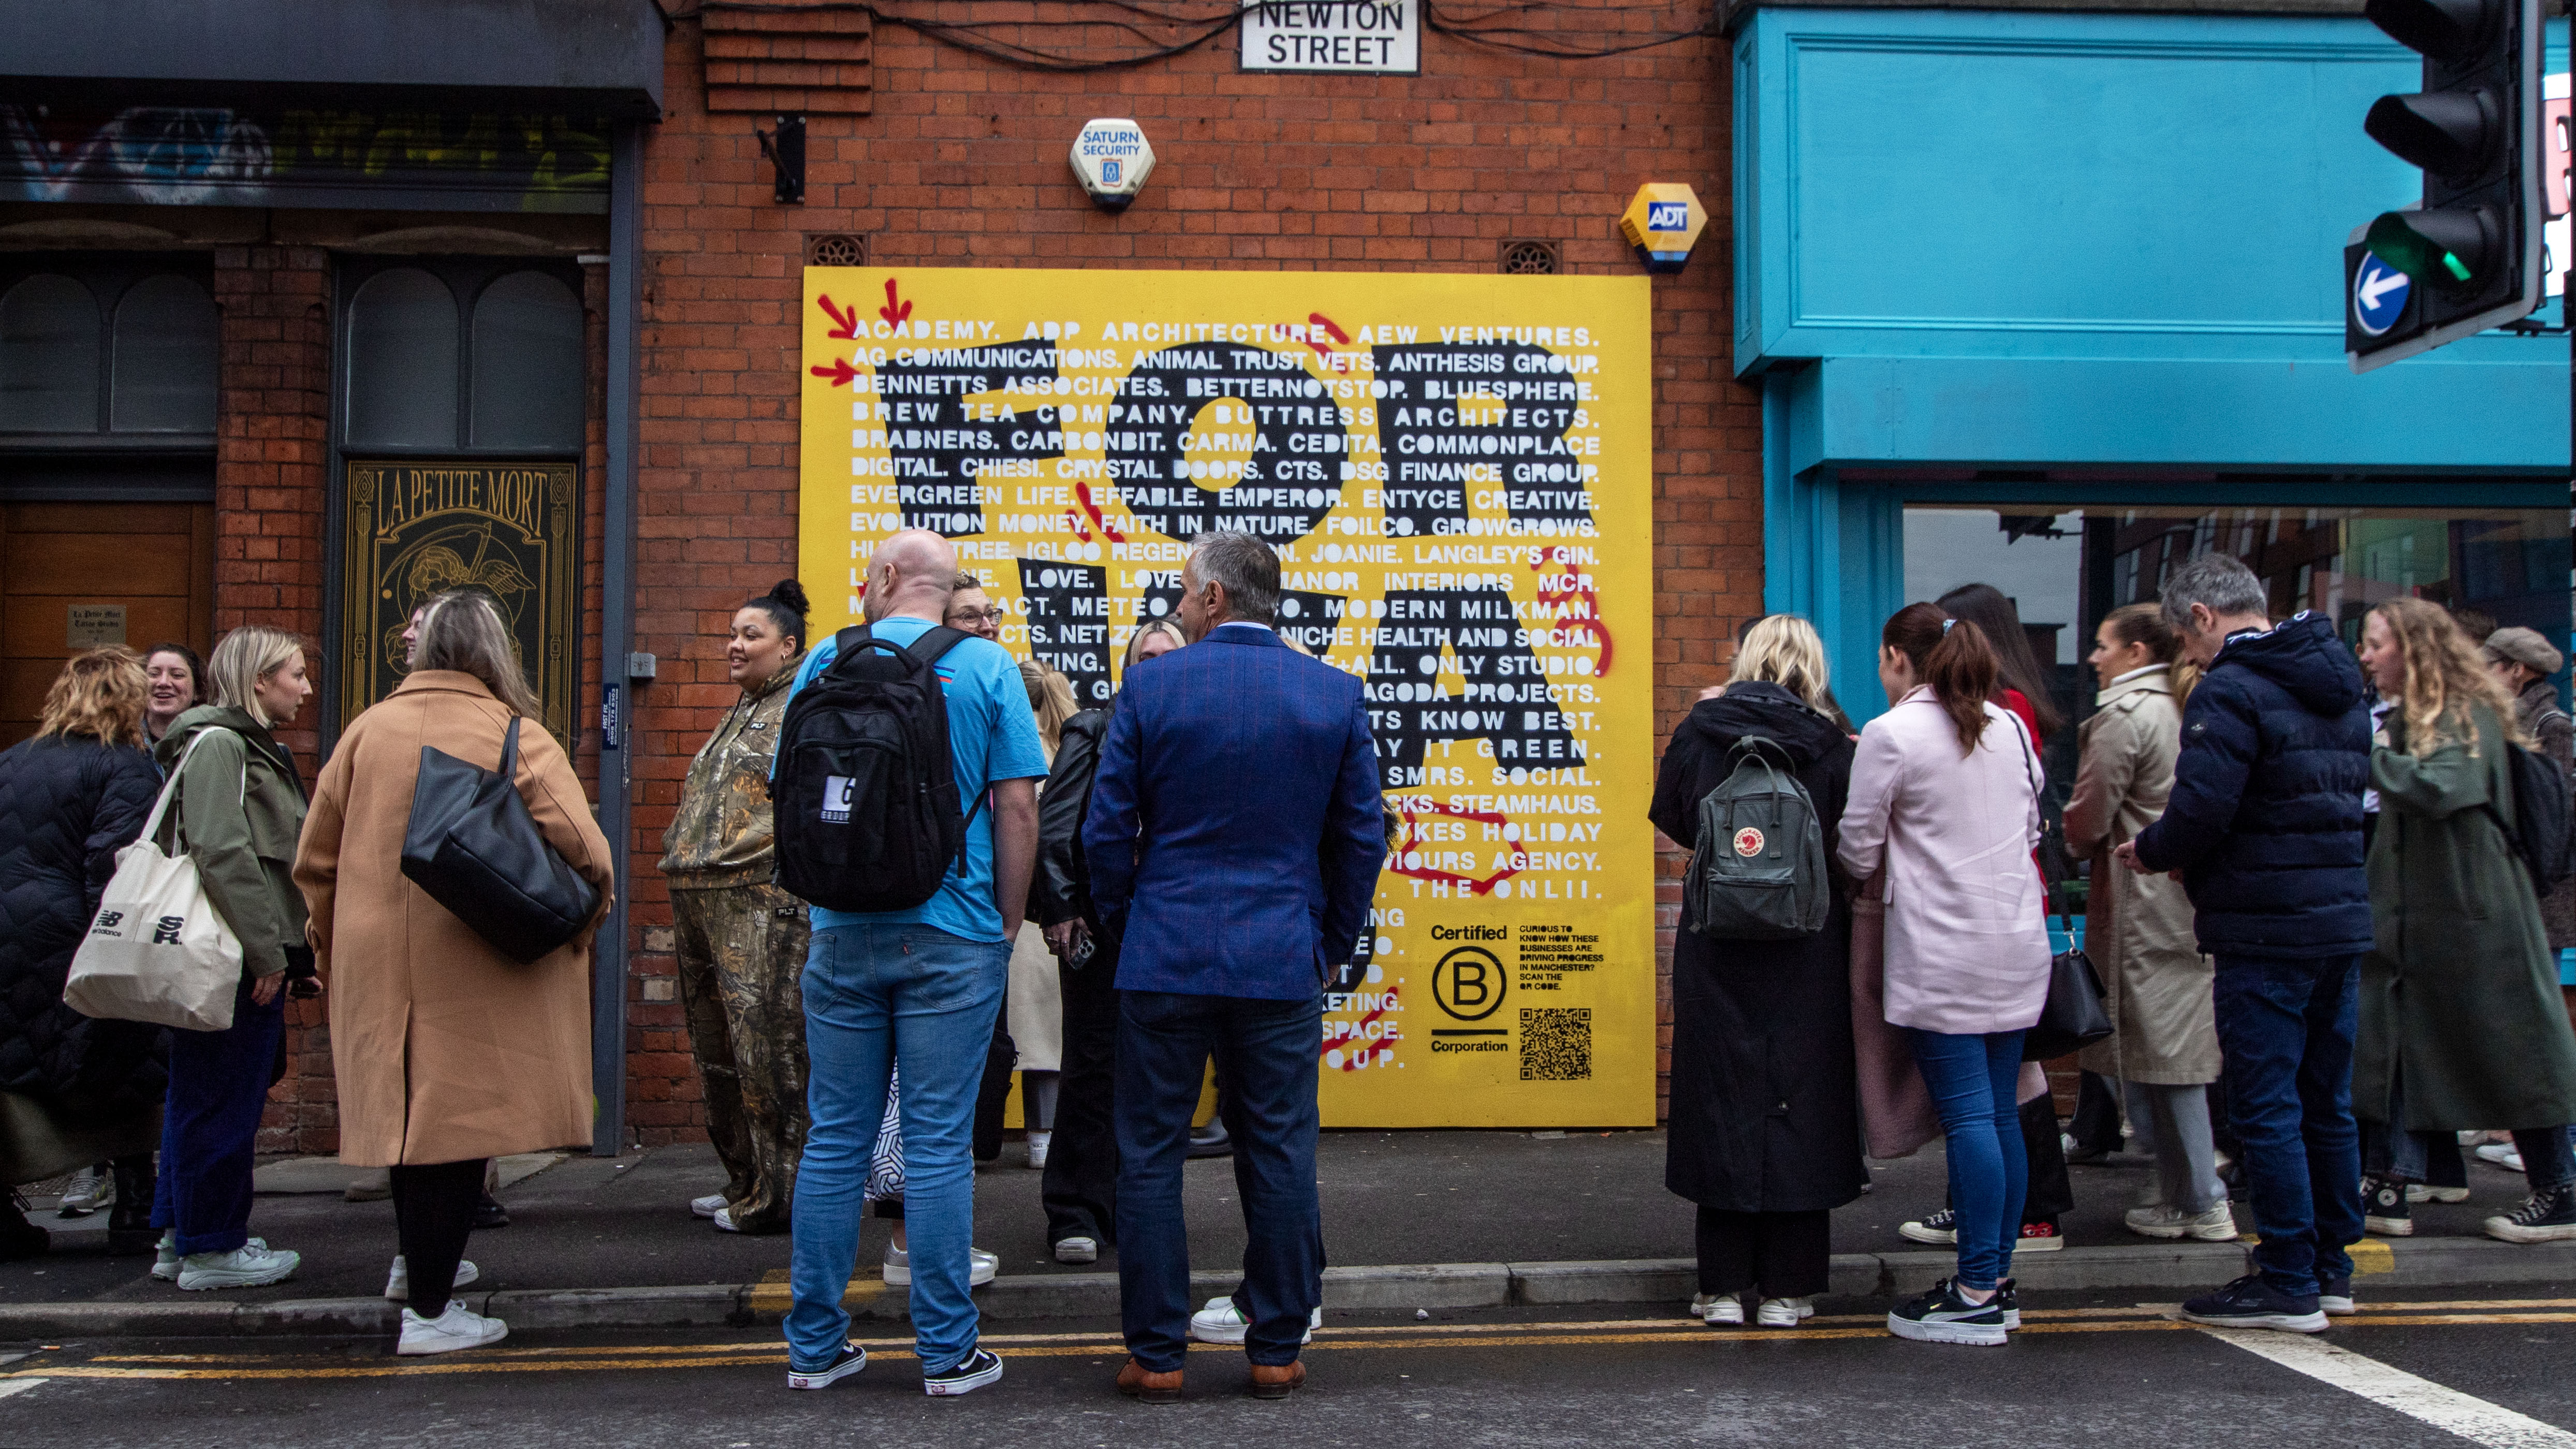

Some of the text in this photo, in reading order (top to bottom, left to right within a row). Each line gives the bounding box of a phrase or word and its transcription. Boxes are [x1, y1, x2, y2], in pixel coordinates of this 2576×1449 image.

[1258, 1, 1403, 31] NEWTON
[1267, 34, 1395, 66] STREET
[1083, 131, 1139, 143] SATURN
[1083, 145, 1140, 156] SECURITY
[1649, 206, 1688, 227] ADT
[853, 319, 1599, 347] ACADEMY. ADP ARCHITECTURE. AEW VENTURES.
[852, 346, 1599, 374] AG COMMUNICATIONS. ANIMAL TRUST VETS. ANTHESIS GROUP.
[852, 373, 1599, 401] BENNETTS ASSOCIATES. BETTERNOTSTOP. BLUESPHERE.
[852, 401, 1600, 429] BREW TEA COMPANY. BUTTRESS ARCHITECTS.
[852, 429, 1600, 457] BRABNERS. CARBONBIT. CARMA. CEDITA. COMMONPLACE
[851, 457, 1600, 483] DIGITAL. CHIESI. CRYSTAL DOORS. CTS. DSG FINANCE GROUP.
[376, 470, 547, 536] LA PETITE MORT
[851, 484, 1600, 510] EVERGREEN LIFE. EFFABLE. EMPEROR. ENTYCE CREATIVE.
[850, 511, 1600, 538] EVOLUTION MONEY. FAITH IN NATURE. FOILCO. GROWGROWS.
[1027, 541, 1102, 562] IGLOO
[1310, 543, 1403, 564] JOANIE.
[1552, 545, 1600, 565] GIN.
[1026, 568, 1094, 588] LOVE.
[1384, 572, 1514, 593] INTERIORS
[1538, 573, 1600, 593] MCR.
[1325, 599, 1445, 619] MODERN
[1461, 600, 1600, 620] MILKMAN.
[1060, 624, 1107, 643] NET
[1280, 626, 1354, 646] NICHE
[1360, 627, 1451, 647] HEALTH
[1457, 628, 1507, 647] AND
[1514, 627, 1601, 649] SOCIAL
[1419, 655, 1485, 676] ONLY
[1497, 655, 1601, 676] STUDIO.
[1364, 682, 1601, 704] AGODA PROJECTS.
[1421, 710, 1505, 730] KNOW
[1524, 711, 1601, 731] BEST.
[1425, 738, 1455, 758] IT
[1476, 738, 1601, 759] GREEN.
[1388, 766, 1601, 787] SMRS. SOCIAL.
[1449, 794, 1602, 815] STEAMHAUS.
[1396, 822, 1602, 843] YKES HOLIDAY
[1491, 851, 1602, 871] AGENCY.
[1409, 879, 1602, 899] THE ONLII.
[1431, 925, 1507, 940] Certified
[1453, 961, 1488, 1006] B
[1431, 1041, 1509, 1054] Corporation
